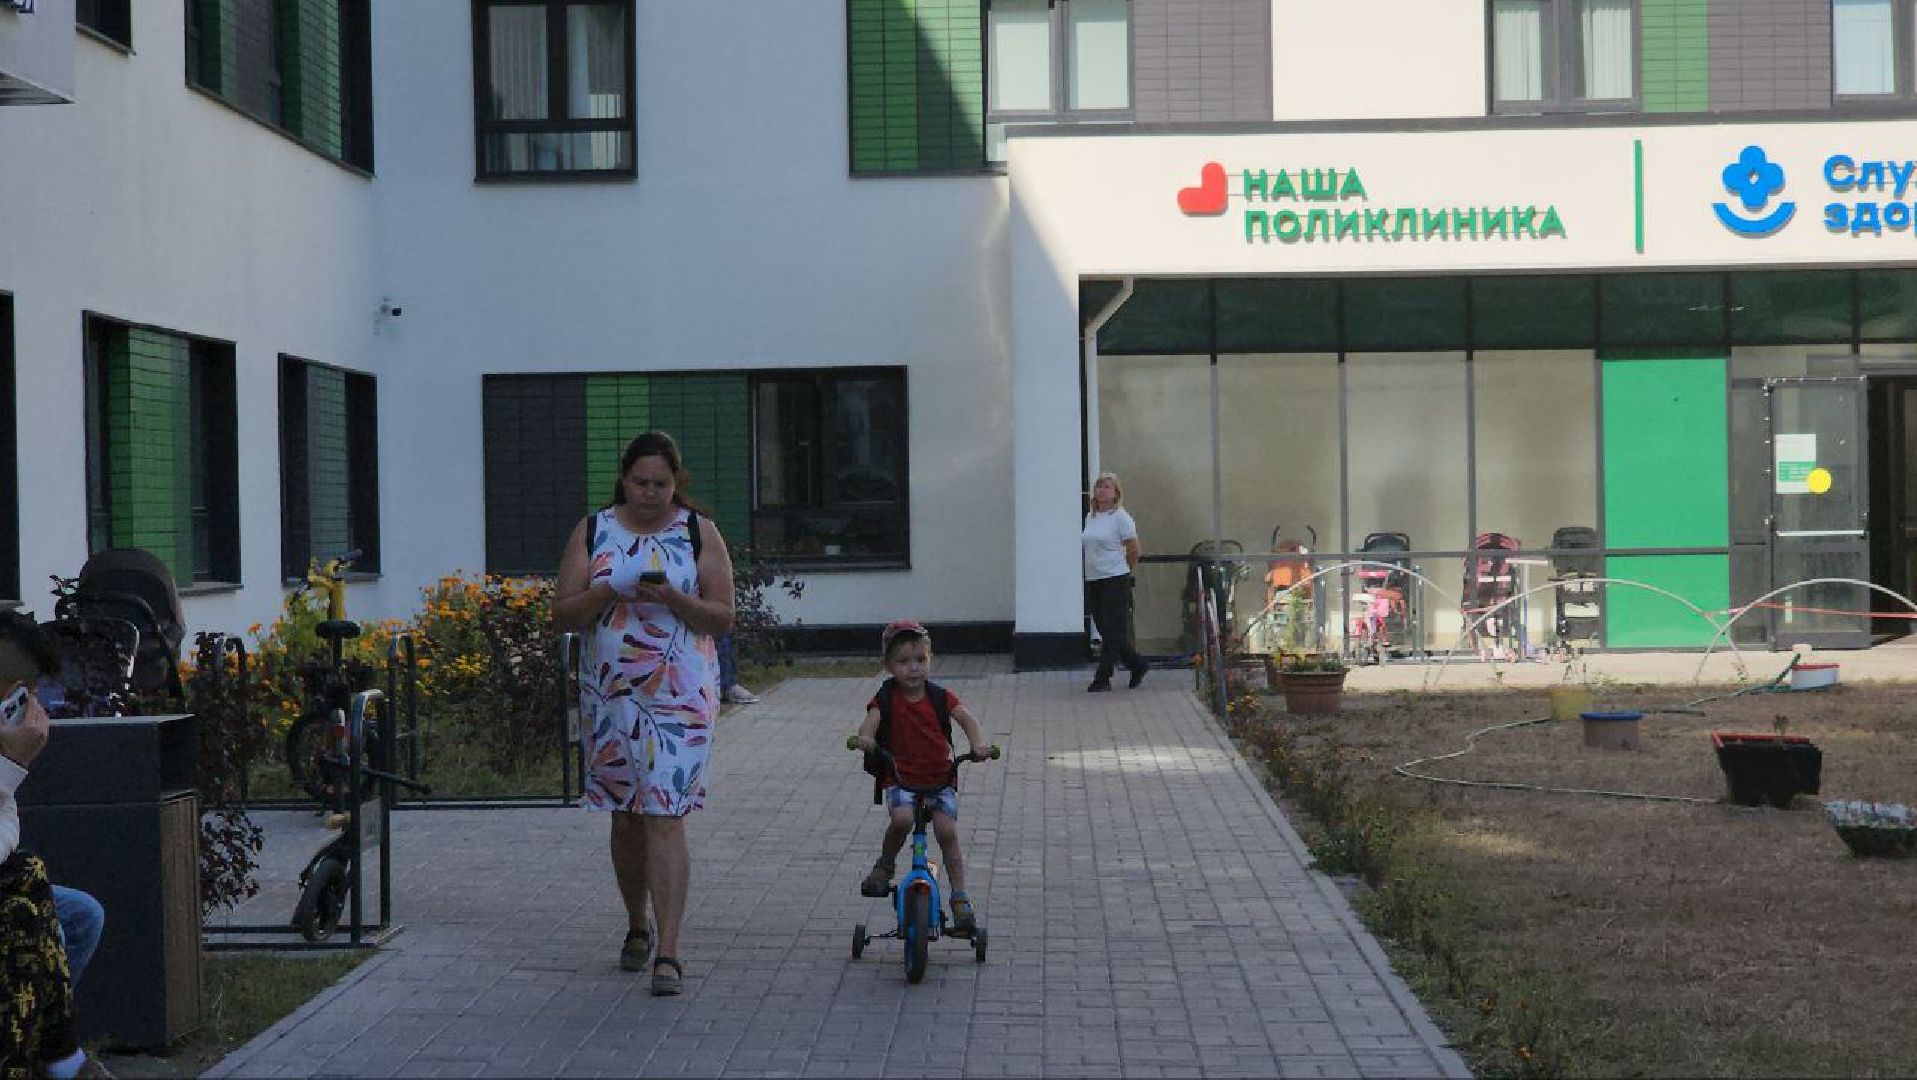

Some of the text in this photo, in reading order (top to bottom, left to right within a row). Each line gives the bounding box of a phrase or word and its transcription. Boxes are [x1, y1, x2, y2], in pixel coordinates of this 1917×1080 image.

[1243, 167, 1367, 202] НАША
[1824, 154, 1917, 200] Слу
[1244, 205, 1568, 244] ПОЛИКЛИНИКА
[1824, 202, 1917, 239] здо
